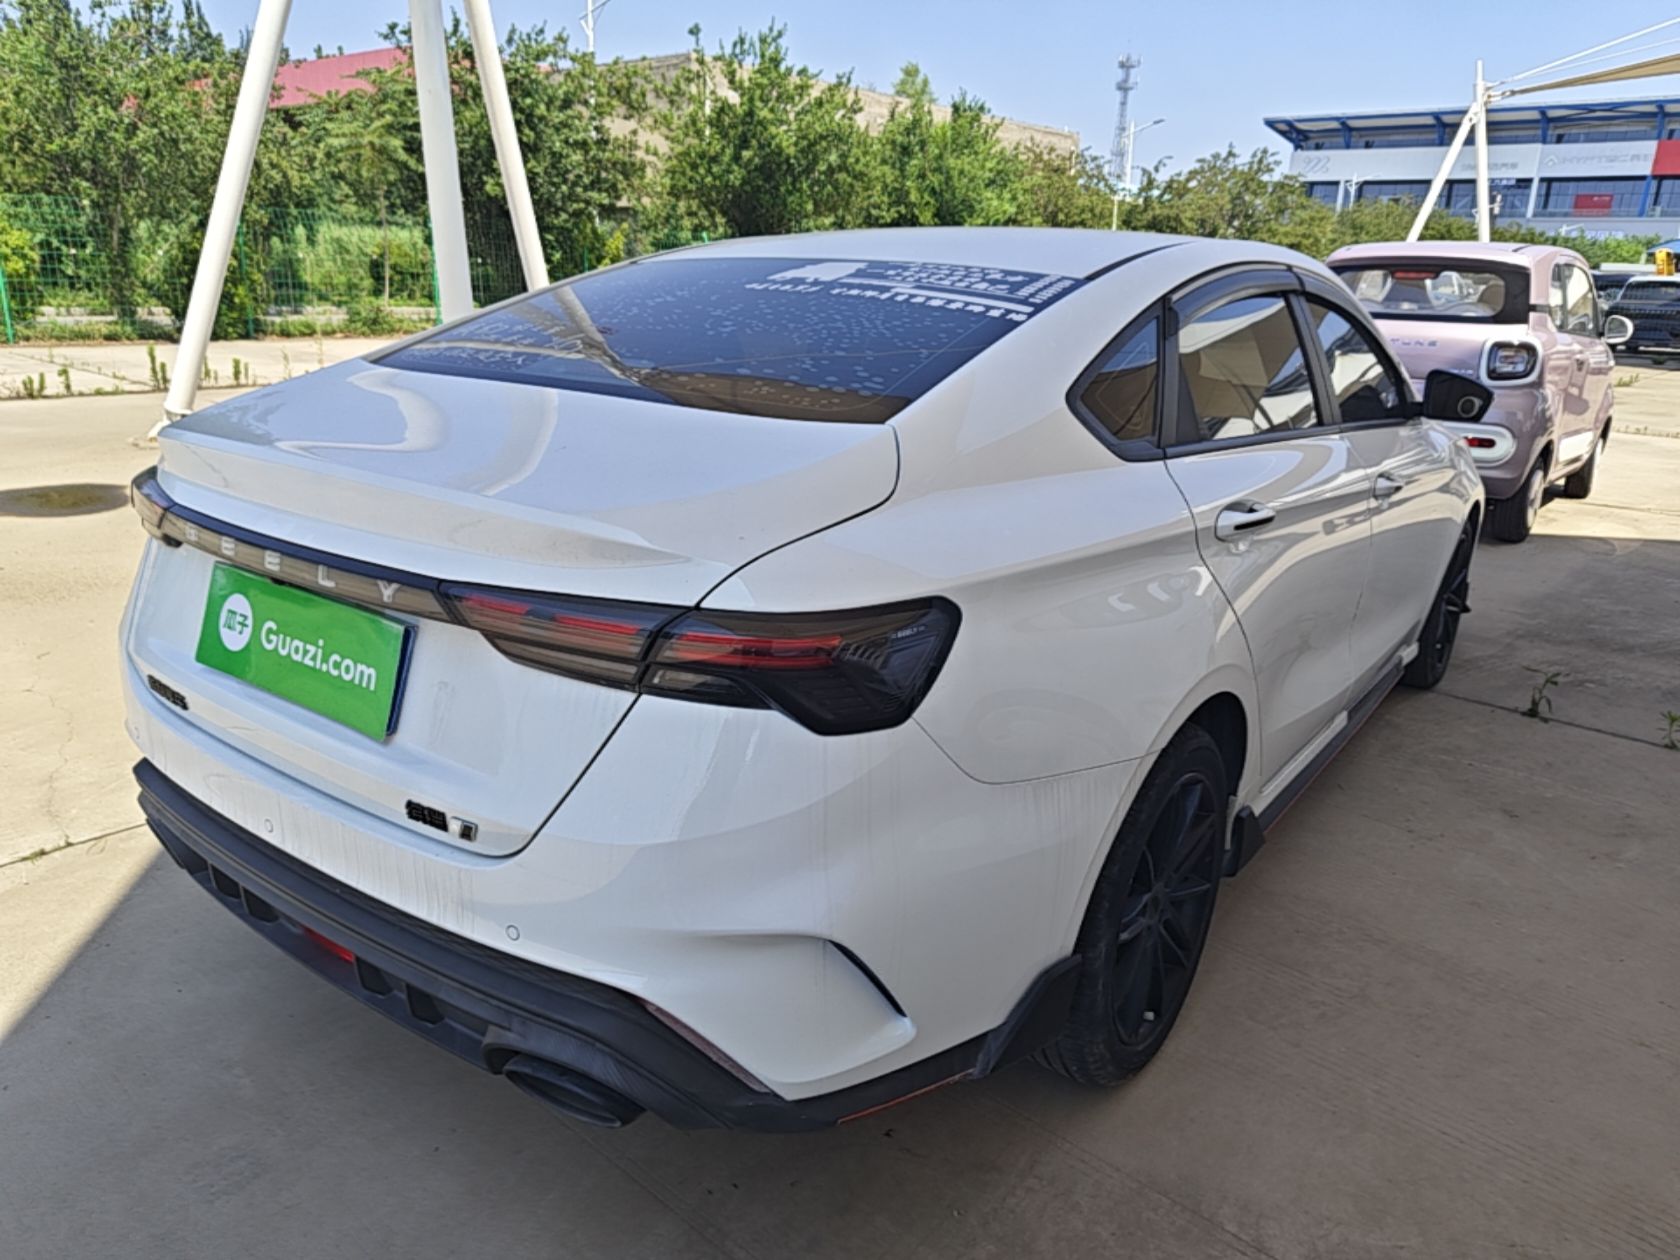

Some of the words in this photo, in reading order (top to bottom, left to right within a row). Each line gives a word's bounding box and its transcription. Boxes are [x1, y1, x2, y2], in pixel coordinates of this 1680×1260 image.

[185, 526, 401, 603] GEELY
[222, 607, 251, 636] 瓜子
[259, 620, 378, 692] Guazi.com
